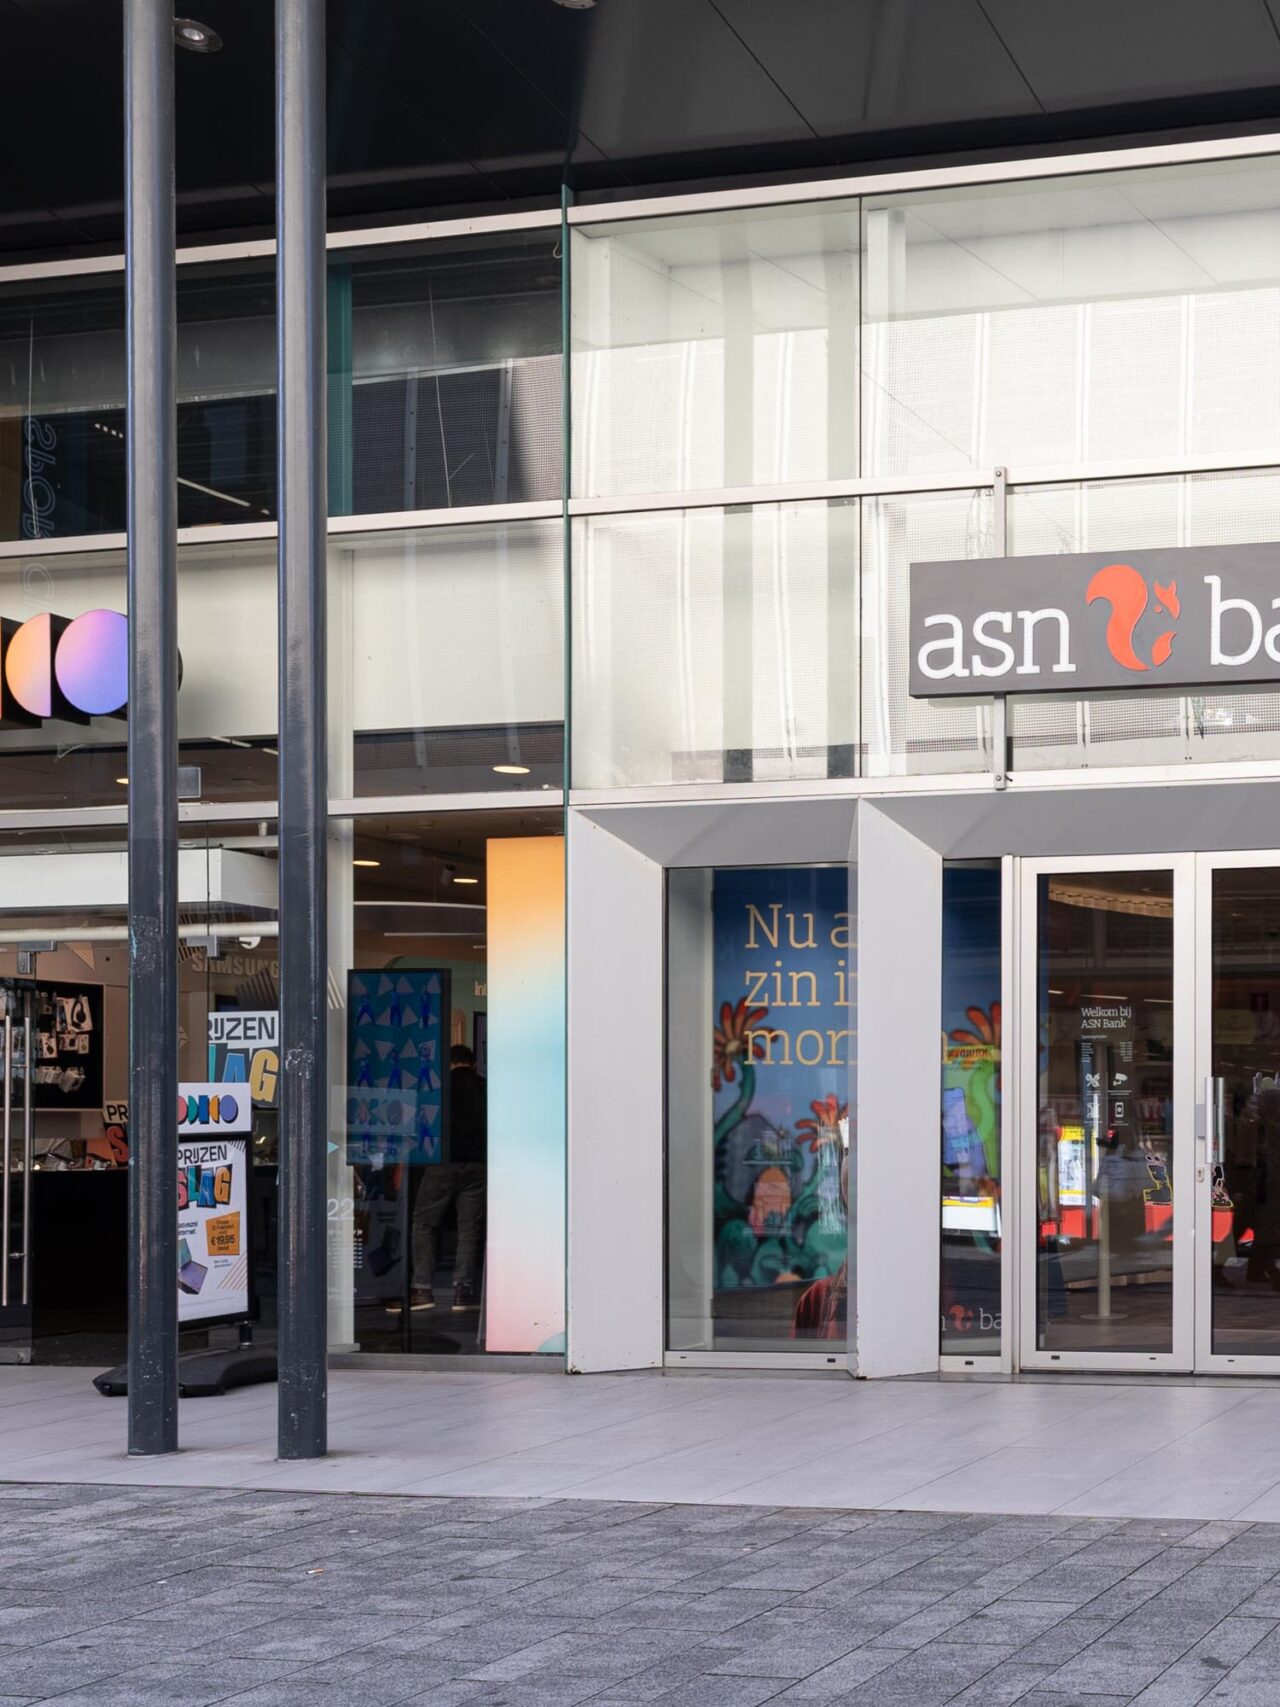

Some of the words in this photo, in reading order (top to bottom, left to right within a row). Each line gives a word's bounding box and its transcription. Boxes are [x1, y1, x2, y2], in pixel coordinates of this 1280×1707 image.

[917, 606, 1076, 680] asn
[745, 904, 818, 949] Nu
[744, 960, 821, 1006] zin
[208, 1017, 276, 1041] IJZEN
[1081, 1006, 1118, 1017] Welkom
[1120, 1006, 1132, 1018] bij
[1081, 1019, 1101, 1028] ASN
[1103, 1018, 1127, 1028] Bank
